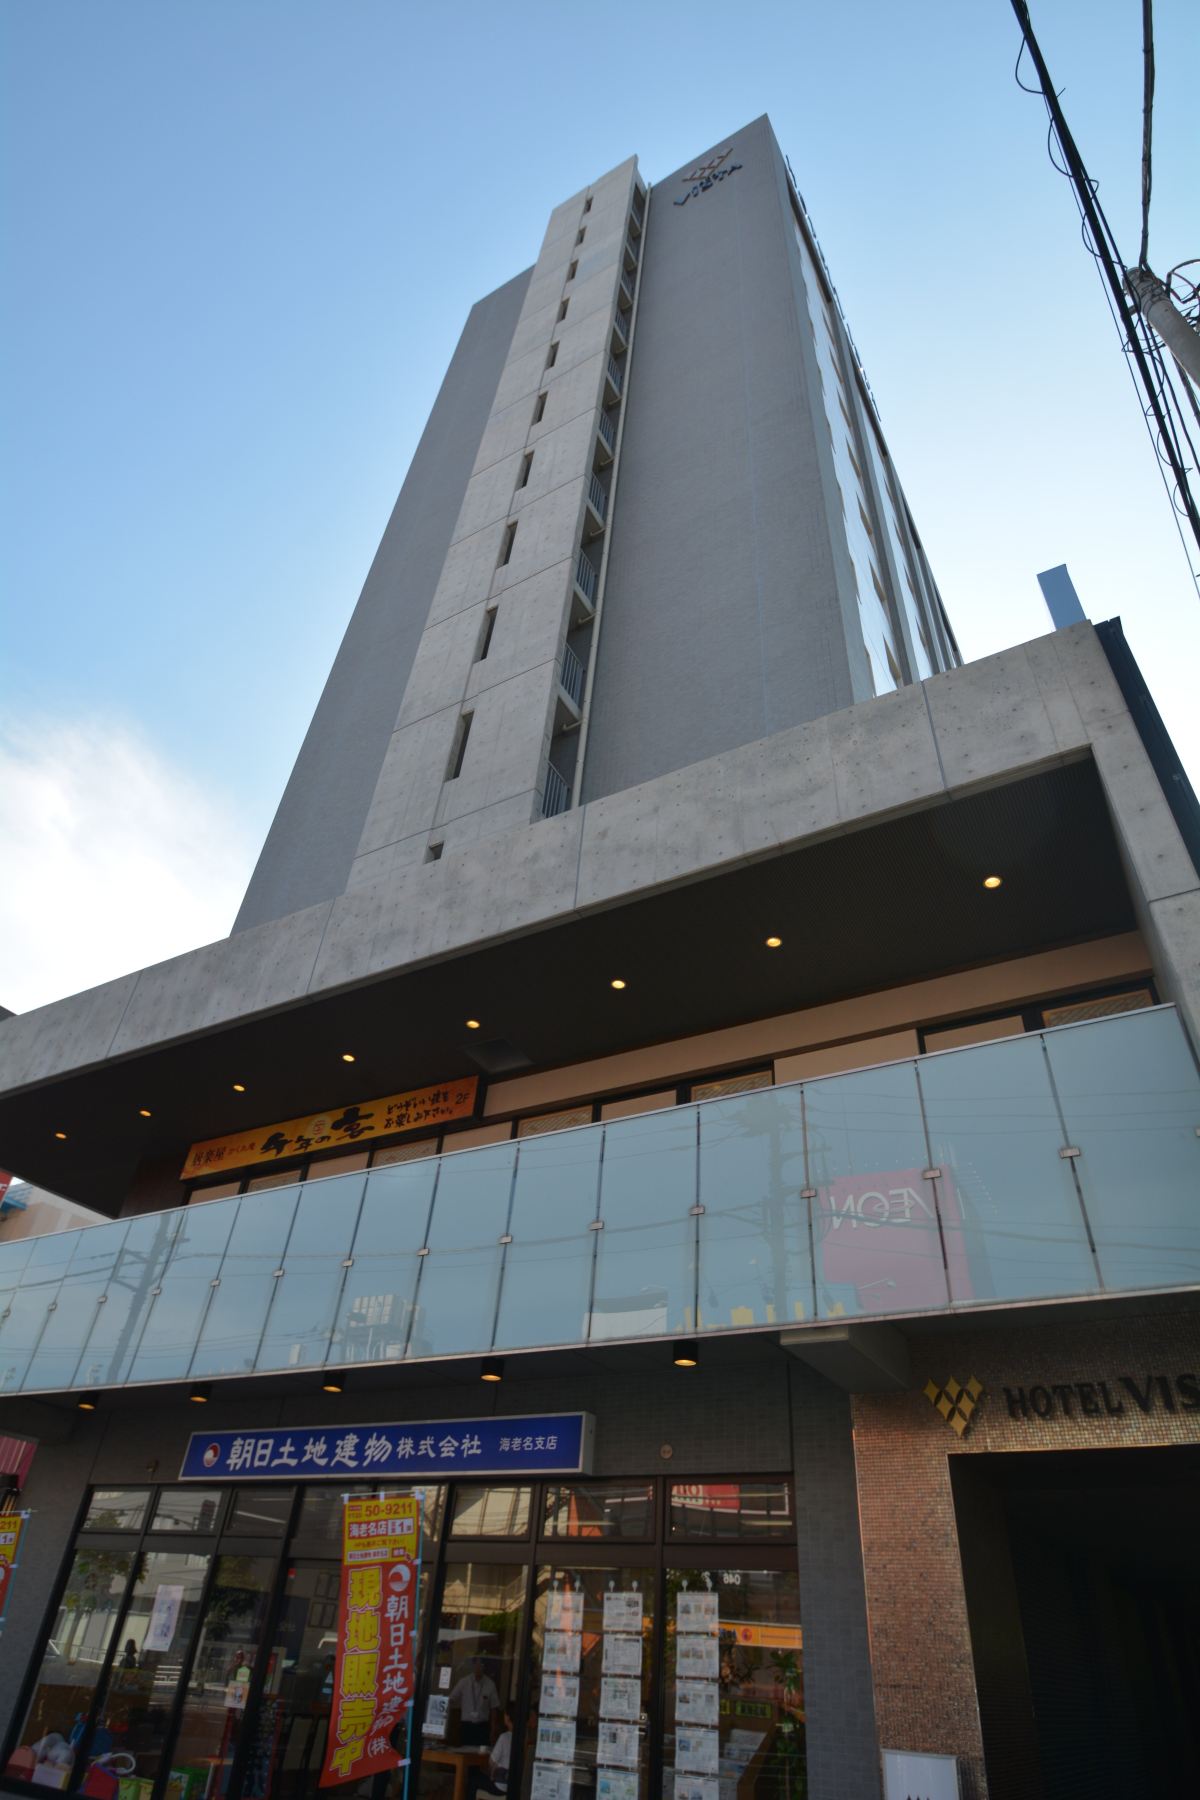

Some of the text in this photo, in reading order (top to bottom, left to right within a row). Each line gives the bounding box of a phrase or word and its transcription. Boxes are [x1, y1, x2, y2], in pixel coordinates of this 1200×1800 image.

[455, 1091, 471, 1106] 2F
[1004, 1373, 1200, 1419] HOTEL VIS
[499, 1436, 559, 1453] 海老名支店
[365, 1502, 413, 1517] 50-9211
[330, 1567, 382, 1777] 現地販売中
